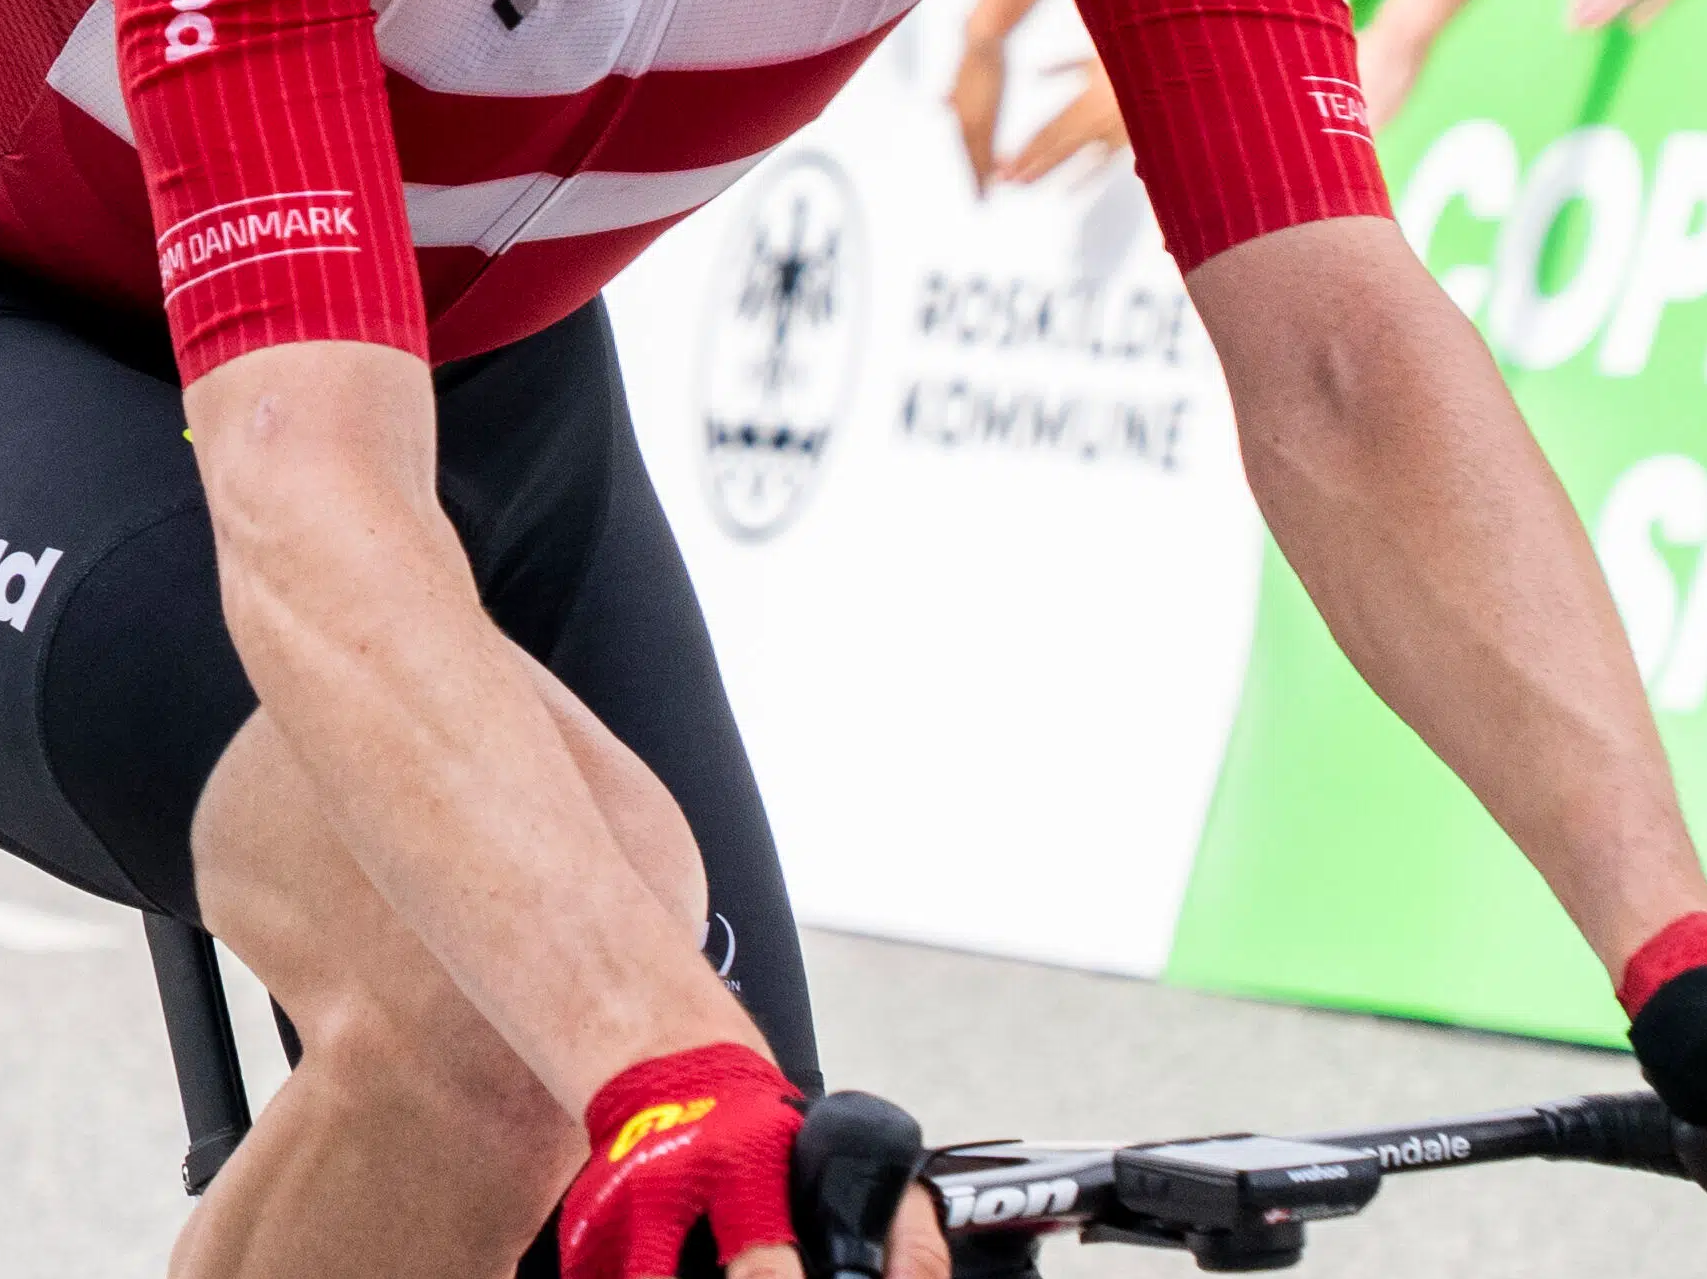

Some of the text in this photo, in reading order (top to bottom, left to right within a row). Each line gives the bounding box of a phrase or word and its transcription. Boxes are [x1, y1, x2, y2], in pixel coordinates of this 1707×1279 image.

[1307, 91, 1368, 128] TEA
[188, 205, 361, 267] DANMARK
[1361, 1131, 1473, 1170] ndale
[944, 1174, 1080, 1229] ion
